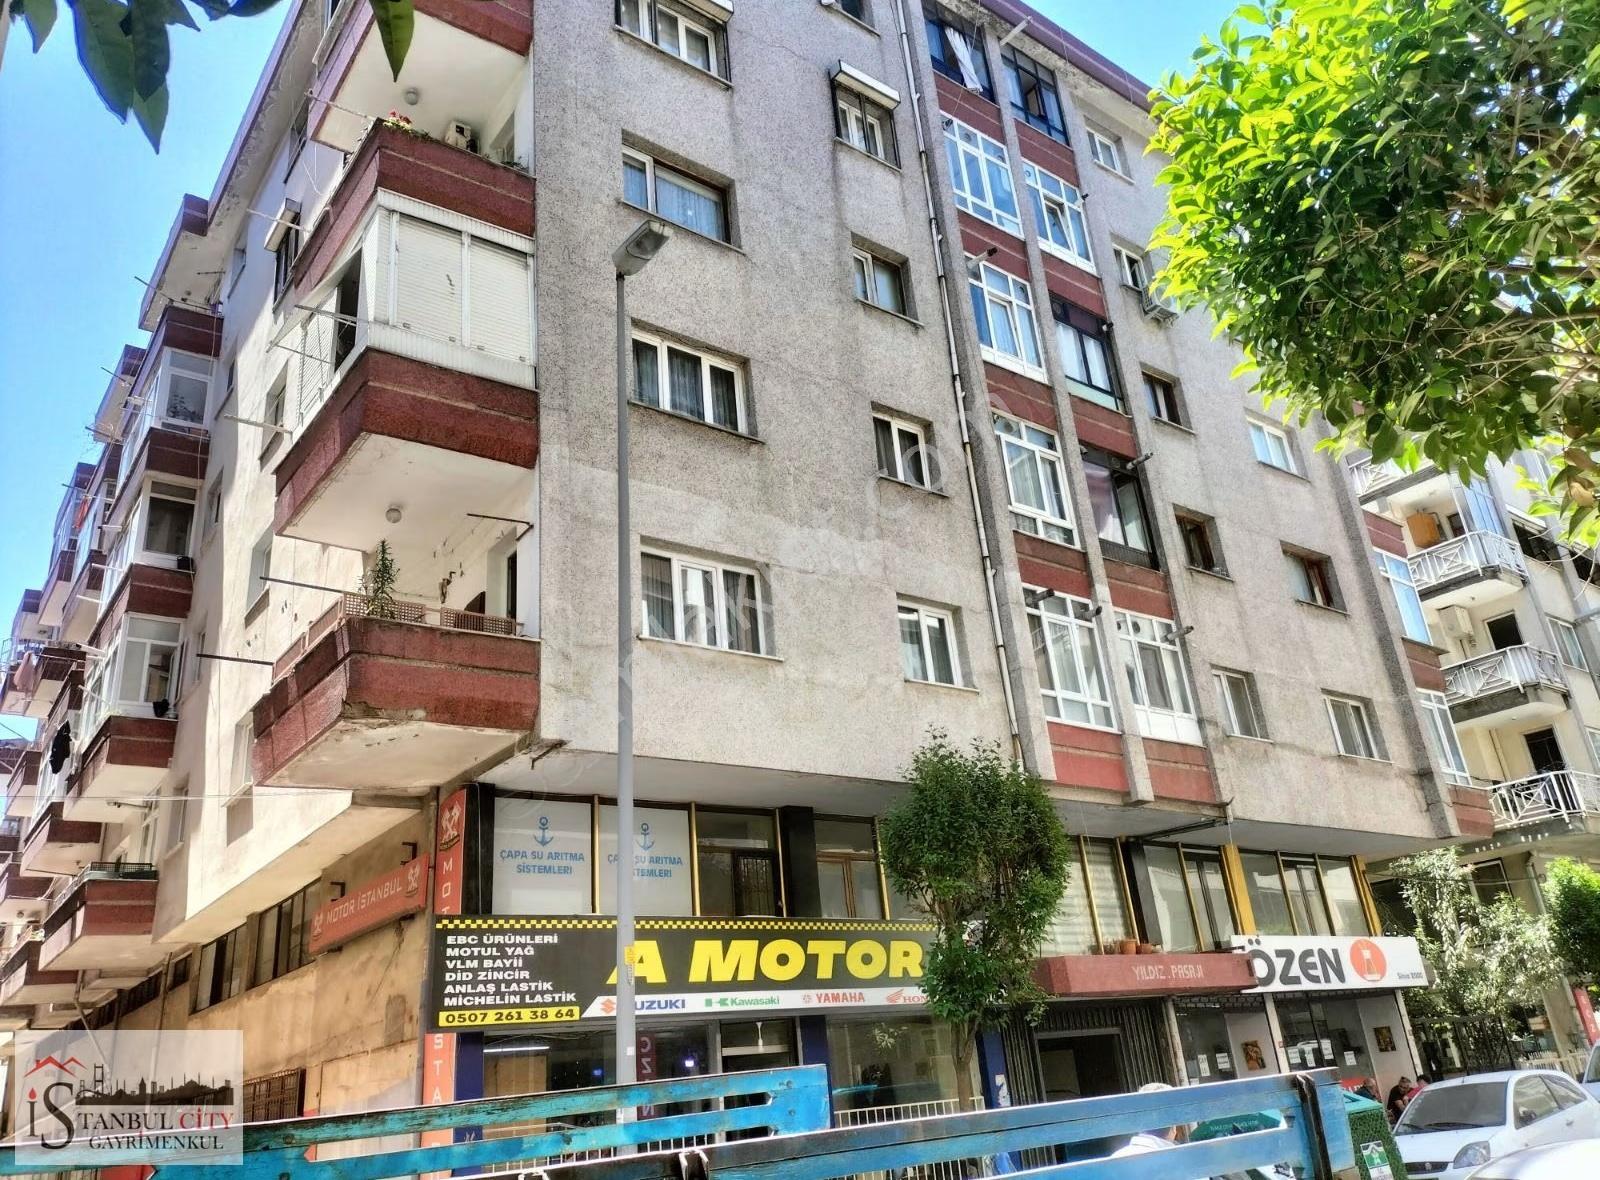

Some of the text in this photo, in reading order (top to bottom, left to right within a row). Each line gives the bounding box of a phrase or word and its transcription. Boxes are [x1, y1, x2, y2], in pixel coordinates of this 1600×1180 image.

[531, 851, 544, 860] SU
[326, 877, 403, 924] MOTOR İSTANBUL
[446, 933, 559, 945] EBC ÜRÜNLERİ
[446, 944, 535, 957] MOTUL YAĞ
[445, 957, 523, 969] VLM BAYİİ
[606, 938, 924, 985] A MOTOR
[1247, 938, 1346, 988] ÖZEN
[445, 968, 530, 981] DİD ZİNCİR
[443, 980, 554, 994] ANLAŞ LASTİK
[443, 991, 577, 1007] MİCHELİN LASTİK
[635, 998, 686, 1011] UZUKI
[730, 995, 780, 1007] Kawasaki
[815, 992, 866, 1004] YAMAHA
[903, 995, 930, 1004] HON
[445, 1008, 575, 1024] 0507 261 38 64
